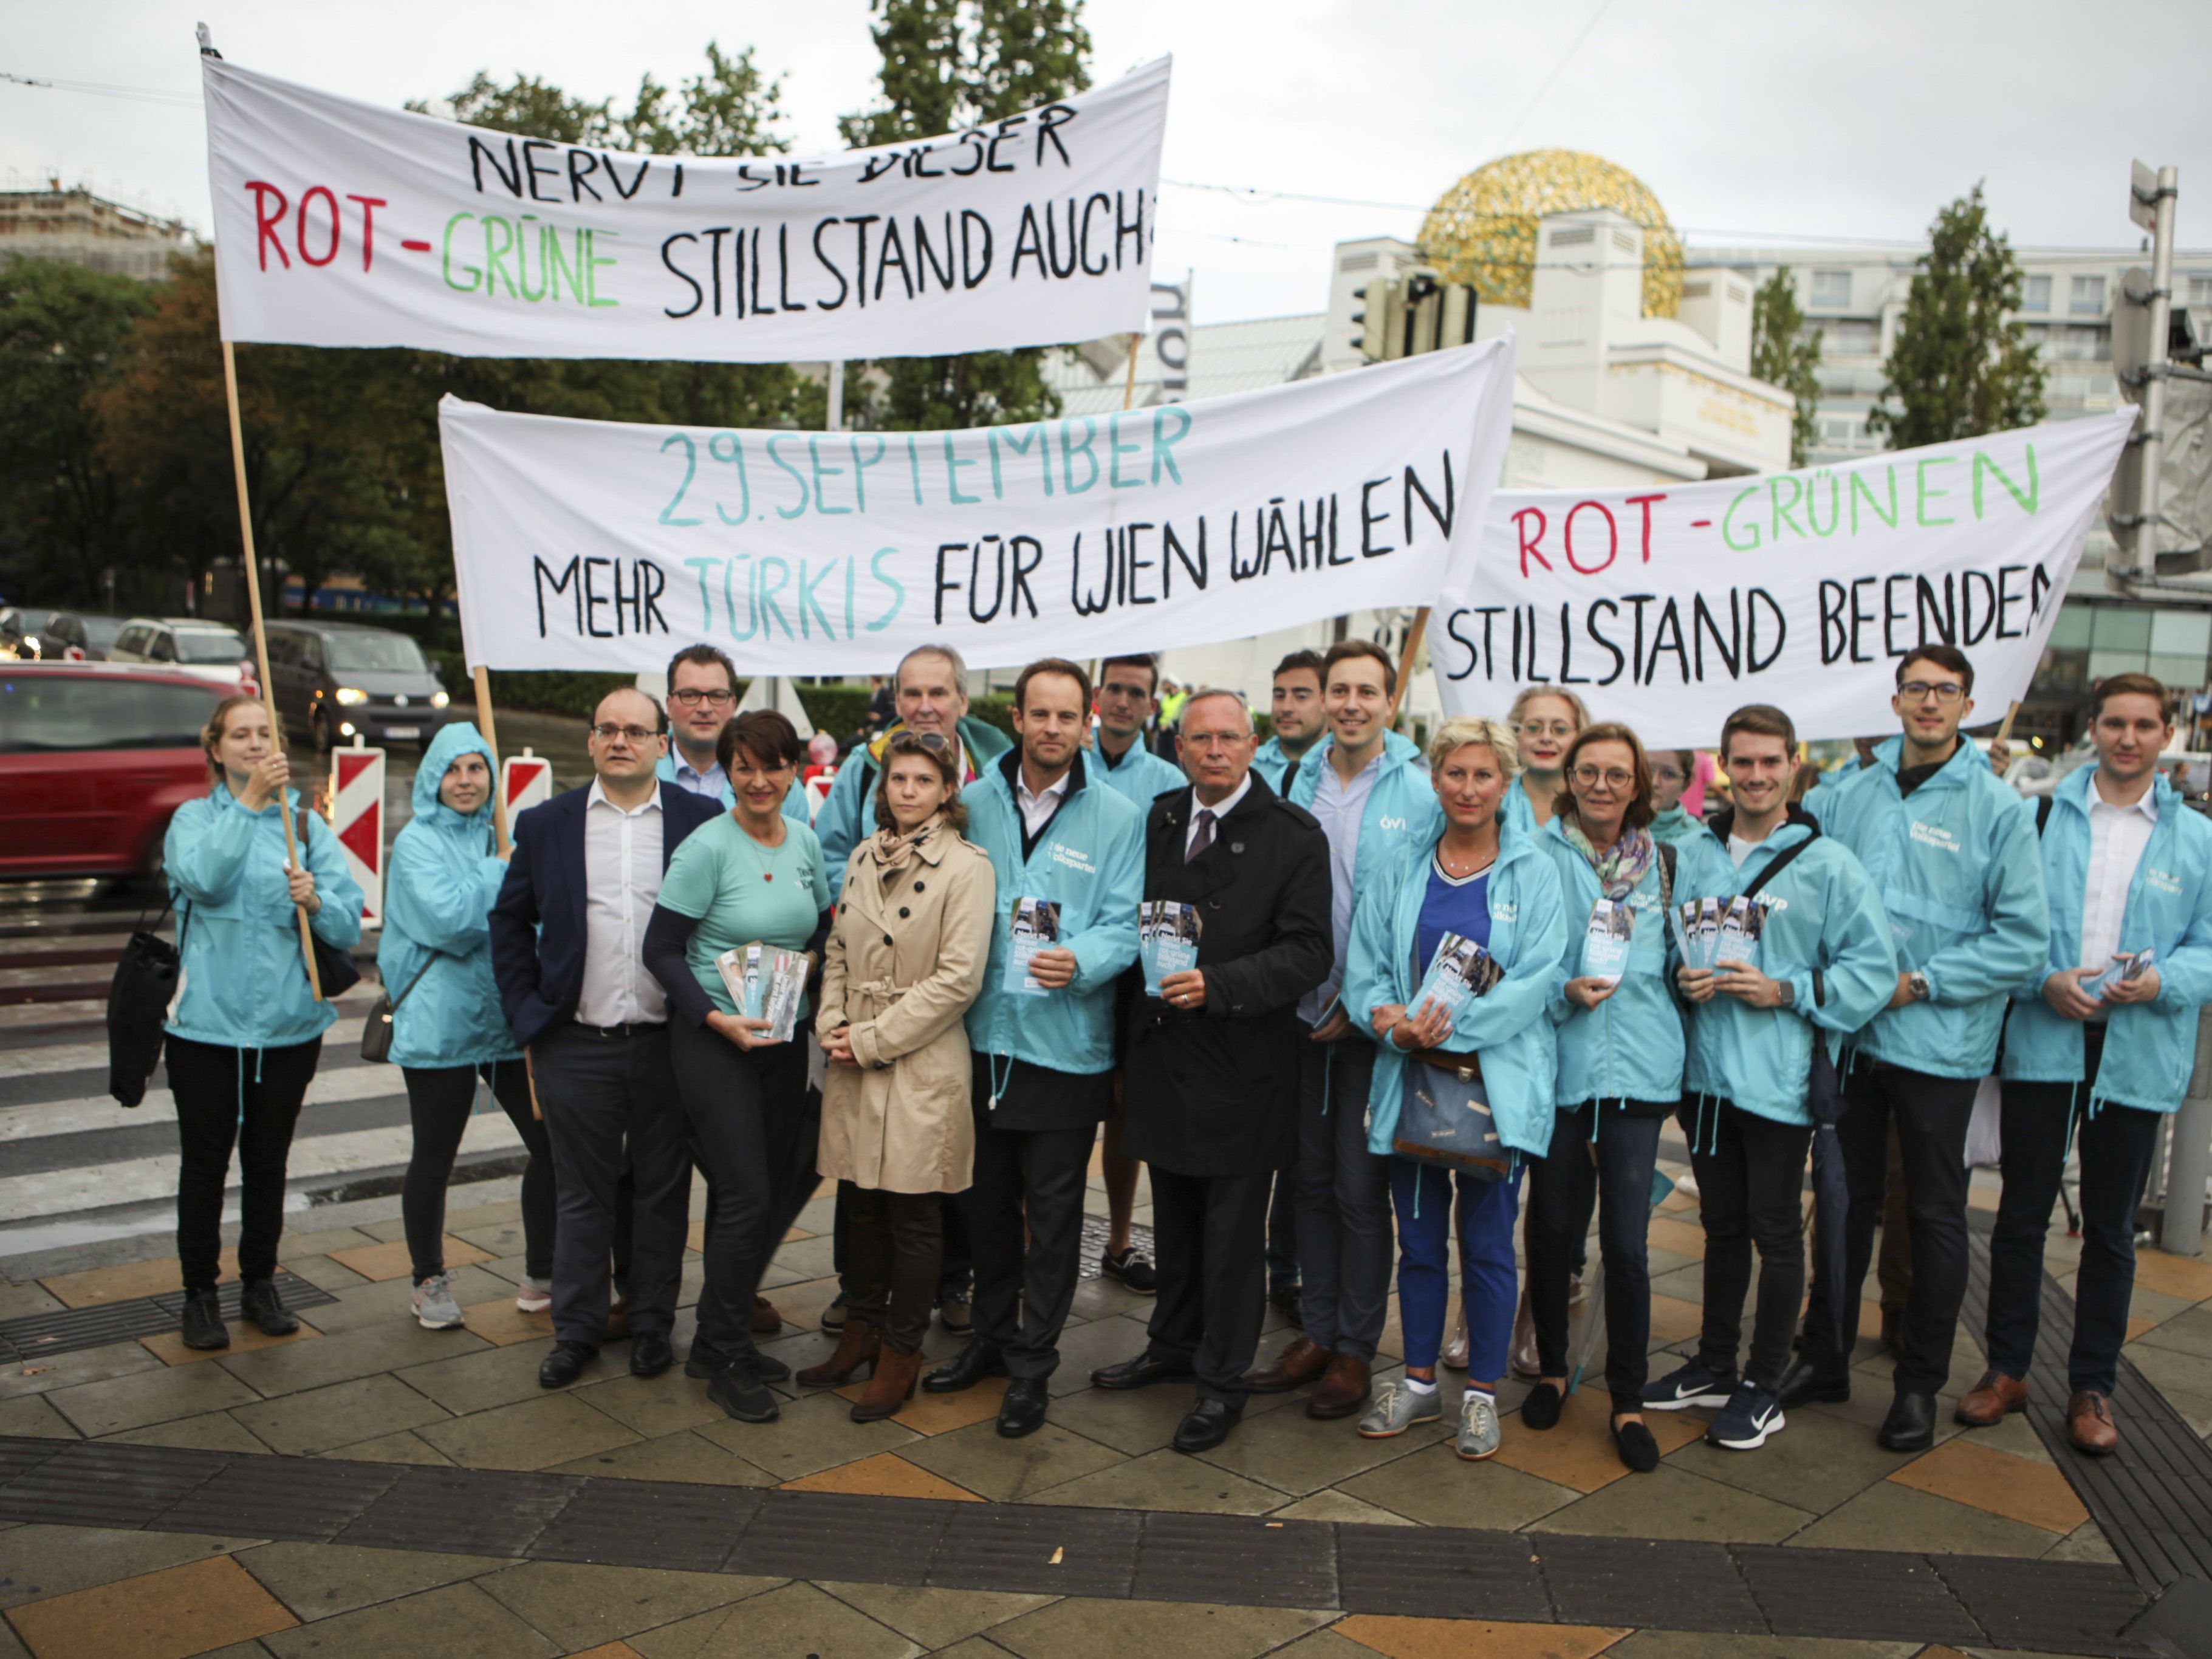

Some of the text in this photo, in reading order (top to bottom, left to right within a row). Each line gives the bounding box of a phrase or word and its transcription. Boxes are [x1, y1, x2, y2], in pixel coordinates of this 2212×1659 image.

[244, 180, 1157, 320] ROT-GRÜNE STILLSTAND AUCH
[534, 448, 1454, 642] MEHR TÜRKIS FÜR WIEN WÄHLEN
[1446, 586, 1787, 686] STILLSTAND
